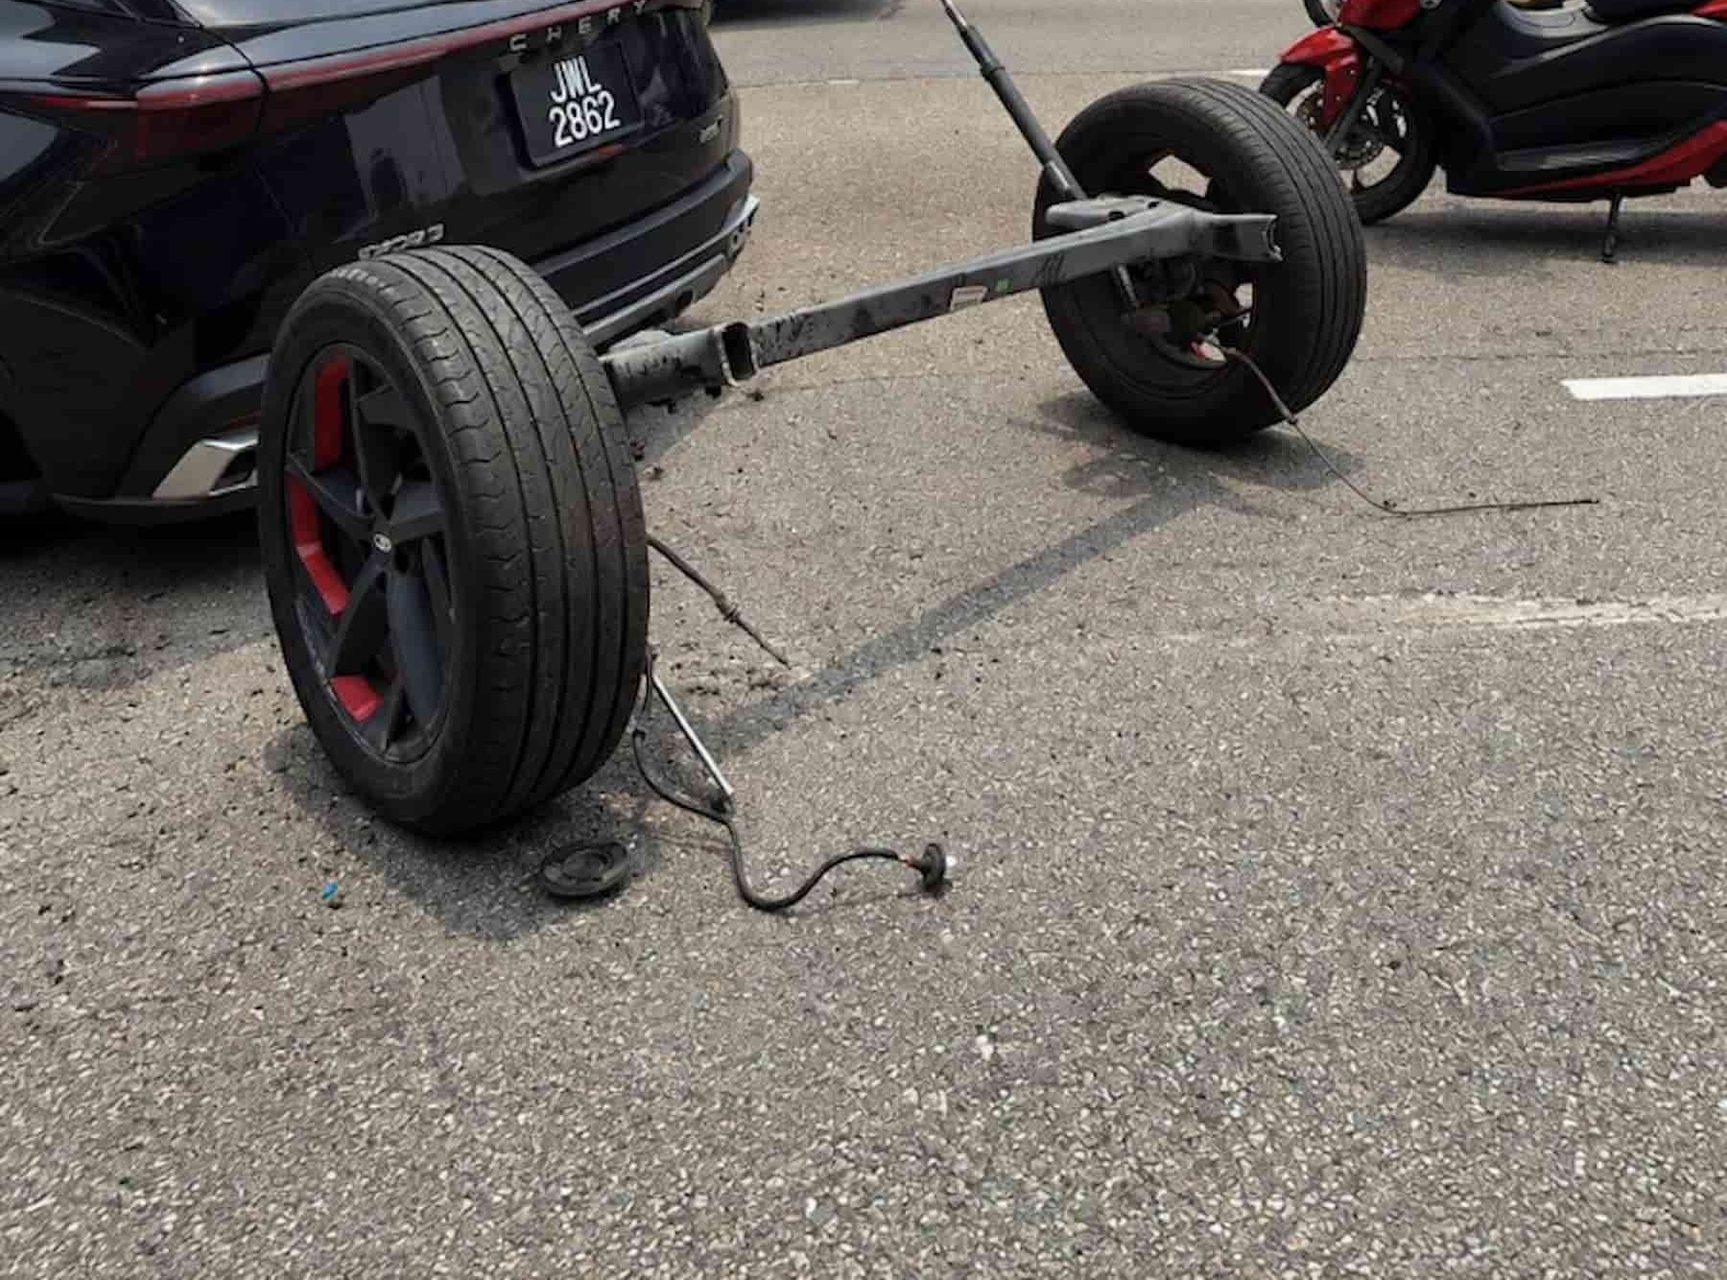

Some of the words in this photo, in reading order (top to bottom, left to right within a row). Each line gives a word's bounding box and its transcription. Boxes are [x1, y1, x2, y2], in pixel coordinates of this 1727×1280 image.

[510, 0, 646, 51] CHERY
[551, 55, 602, 103] JWL
[549, 90, 621, 147] 2862
